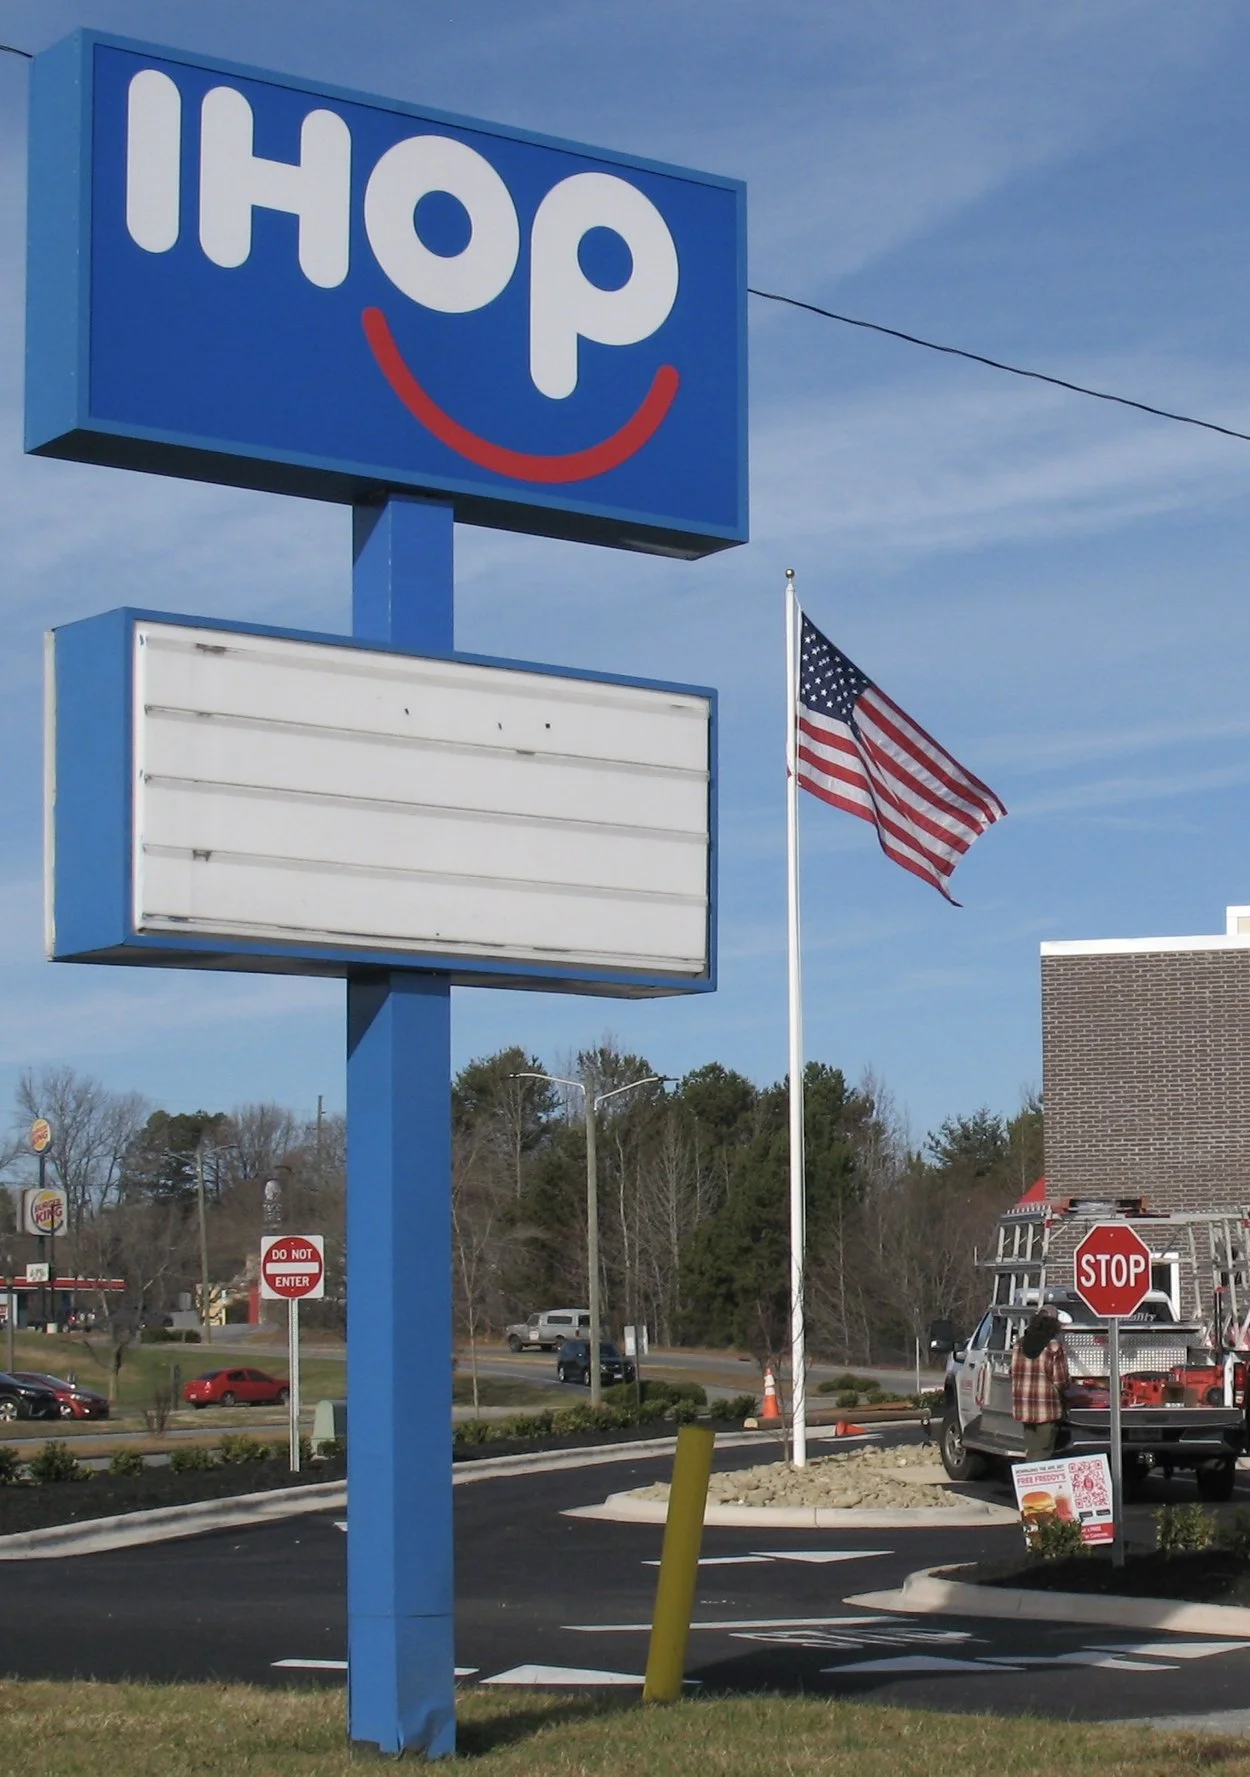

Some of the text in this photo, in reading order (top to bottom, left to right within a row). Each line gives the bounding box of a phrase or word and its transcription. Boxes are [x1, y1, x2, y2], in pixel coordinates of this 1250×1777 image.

[35, 1199, 63, 1213] BURGER
[36, 1206, 63, 1224] KING
[272, 1248, 313, 1260] DO NOT
[1080, 1253, 1146, 1288] STOP
[275, 1276, 309, 1288] ENTER
[1017, 1472, 1066, 1485] FREE FREDDY'S
